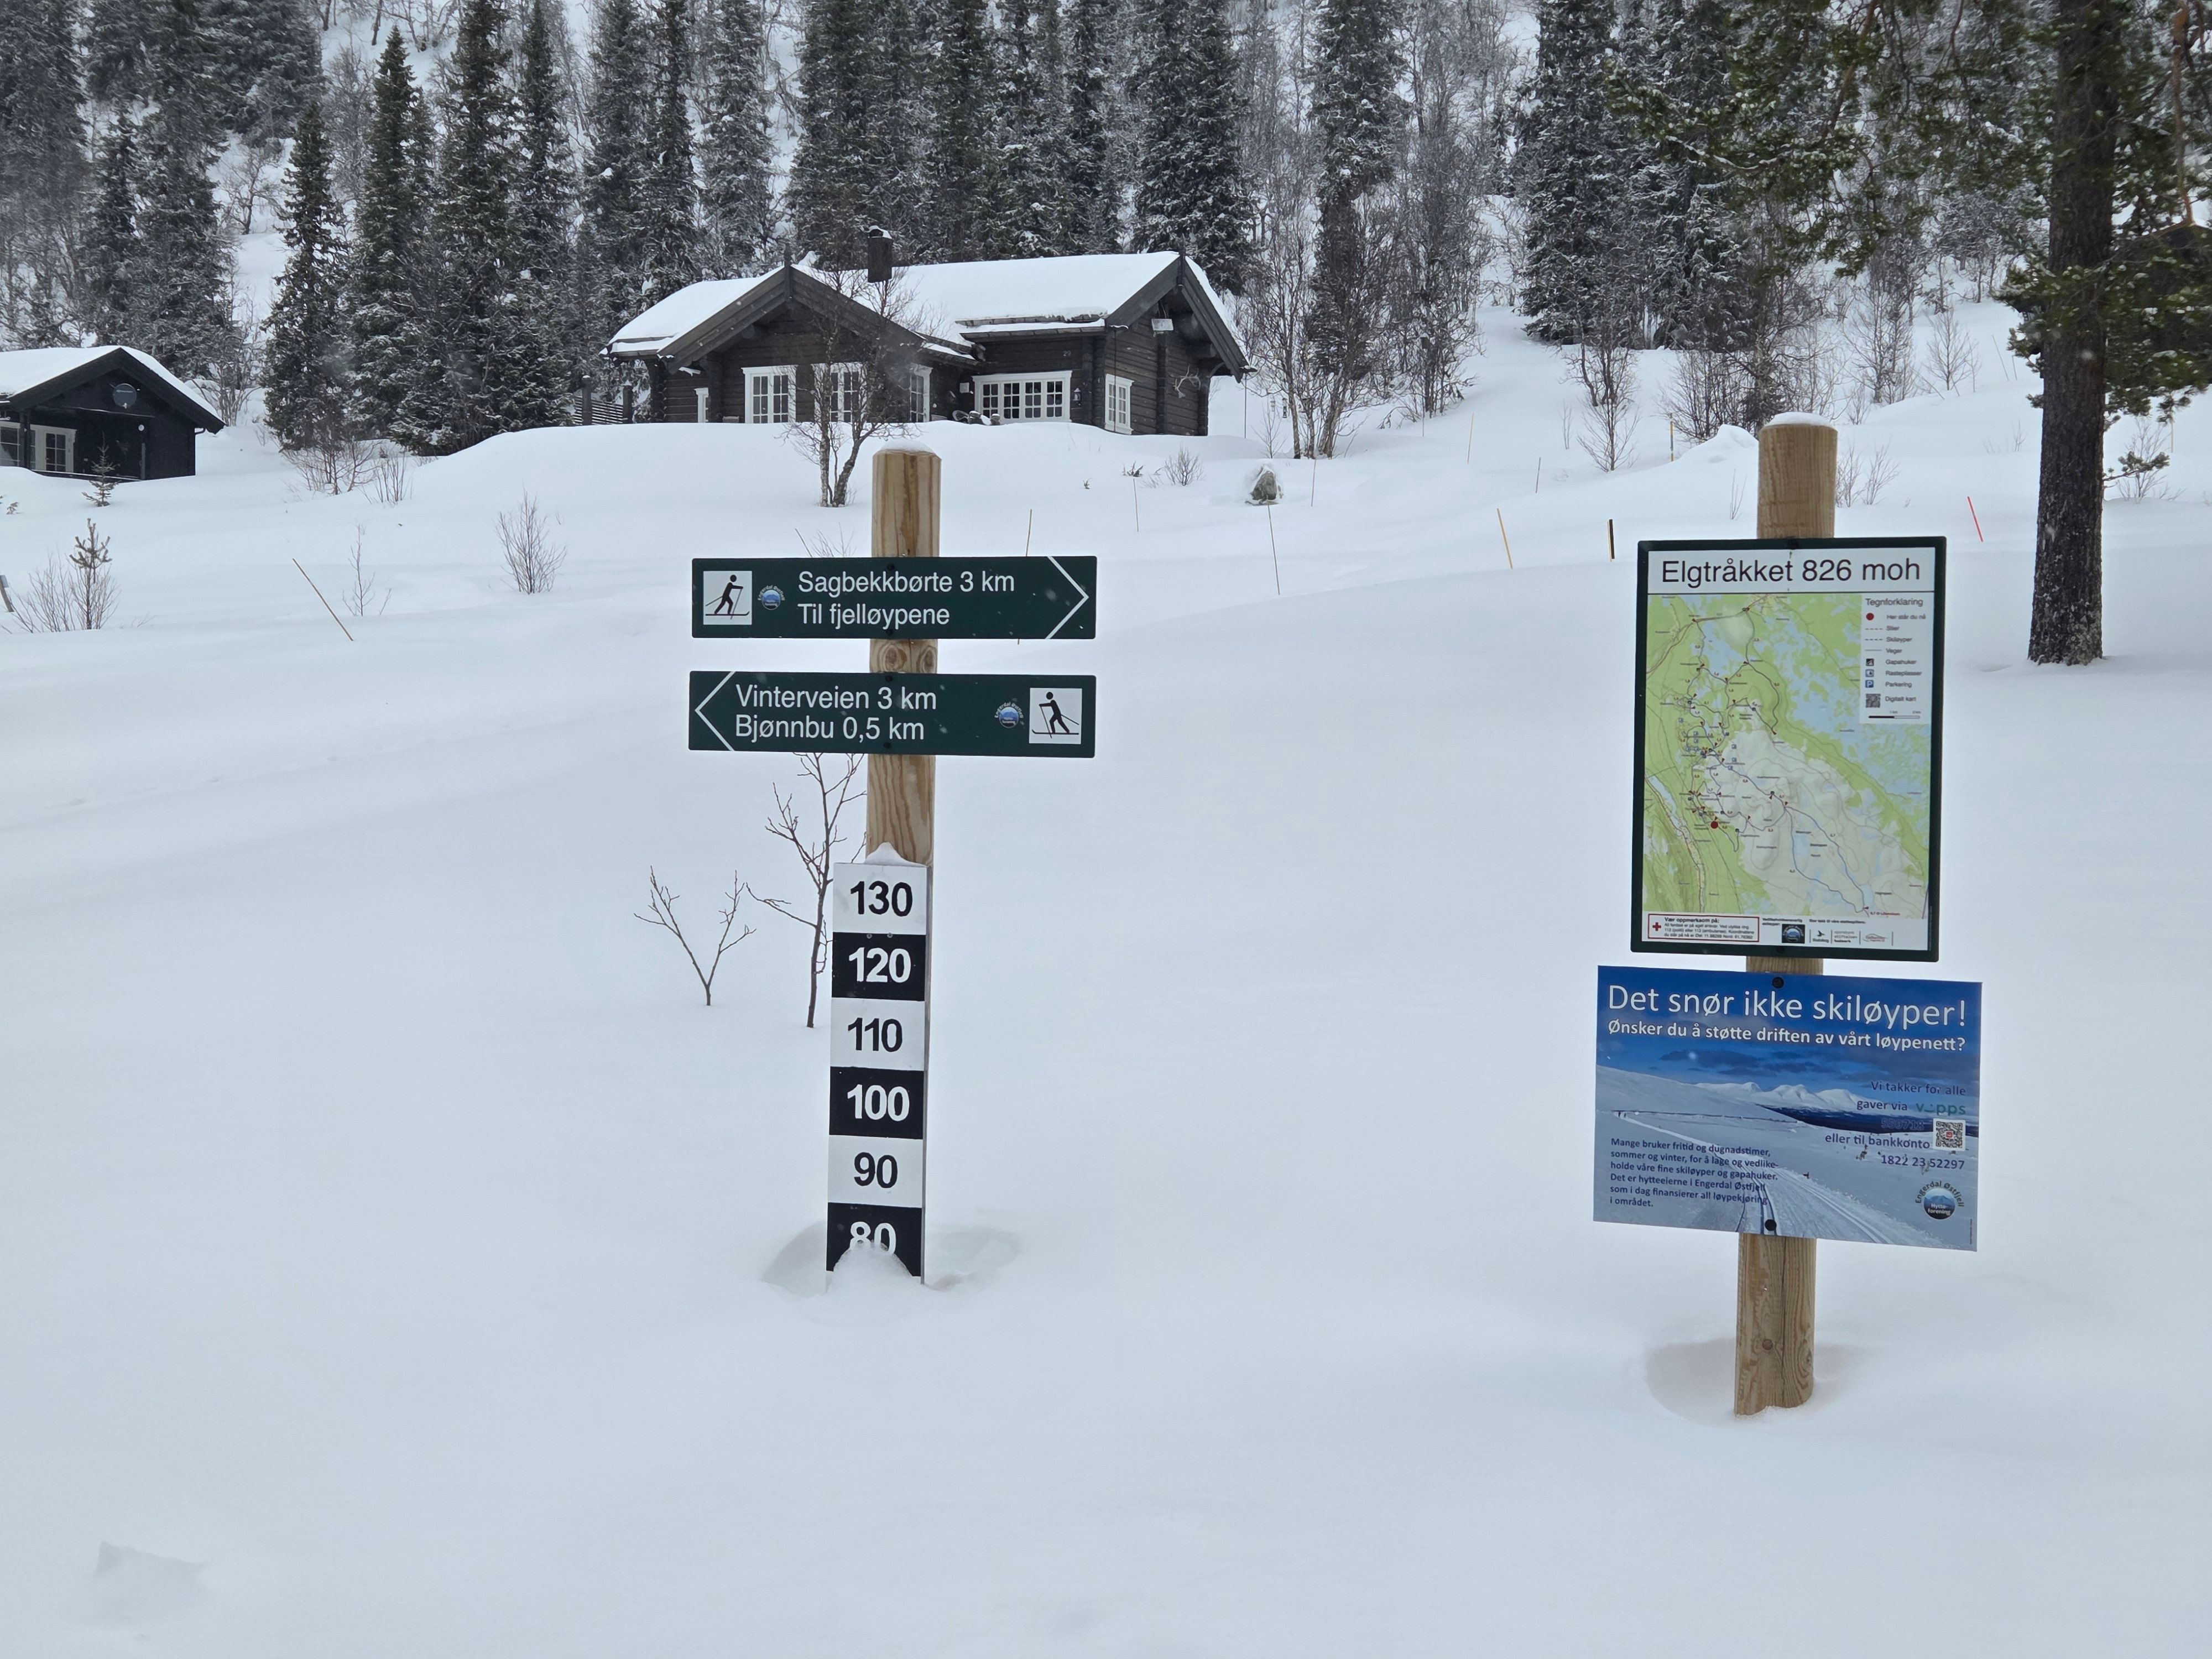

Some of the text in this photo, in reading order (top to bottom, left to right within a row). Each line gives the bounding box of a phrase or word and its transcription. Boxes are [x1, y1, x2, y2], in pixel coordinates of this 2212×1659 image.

[798, 571, 1014, 598] Sagbekkbørte 3 km
[1662, 557, 1920, 588] Elgtråkket 826 moh
[1865, 598, 1923, 607] Tegnforklaring
[797, 603, 950, 630] Til fjelløypene
[735, 684, 936, 709] Vinterveien 3 km
[735, 714, 924, 743] Bjønnbu 0,5 km
[850, 880, 912, 917] 130
[849, 947, 911, 983] 120
[1609, 985, 1965, 1030] Det snør ikke skiløyper!
[848, 1017, 902, 1052] 110
[1608, 1019, 1966, 1052] Ønsker du å støtte driften av vårt løypenett?
[1871, 1081, 1966, 1096] Vi takker for alle
[847, 1084, 910, 1121] 100
[1856, 1100, 1888, 1110] gaver
[1891, 1101, 1908, 1111] via
[1611, 1138, 1771, 1157] Mange bruker fritid og dugnadstimer,
[1825, 1134, 1931, 1150] eller til bankkonto
[854, 1152, 898, 1188] 90
[1610, 1151, 1779, 1169] sommer og vinter, for å lage og vedlike-
[1610, 1161, 1778, 1181] holde våre fine skiløyper og gapahuker.
[1881, 1155, 1965, 1170] 1822 23 52297
[1610, 1173, 1625, 1182] Det
[1639, 1175, 1688, 1187] hytteeierne
[1694, 1179, 1732, 1191] Engerdal
[1734, 1182, 1766, 1192] Østfjell
[1915, 1180, 1965, 1207] Engerdal Østfjell
[1614, 1197, 1654, 1207] området.
[1635, 1187, 1651, 1196] dag
[1652, 1188, 1698, 1199] finansierer
[1700, 1191, 1711, 1199] all
[1713, 1192, 1767, 1205] løypekjøring
[1928, 1208, 1951, 1217] forening
[850, 1222, 896, 1254] 80
